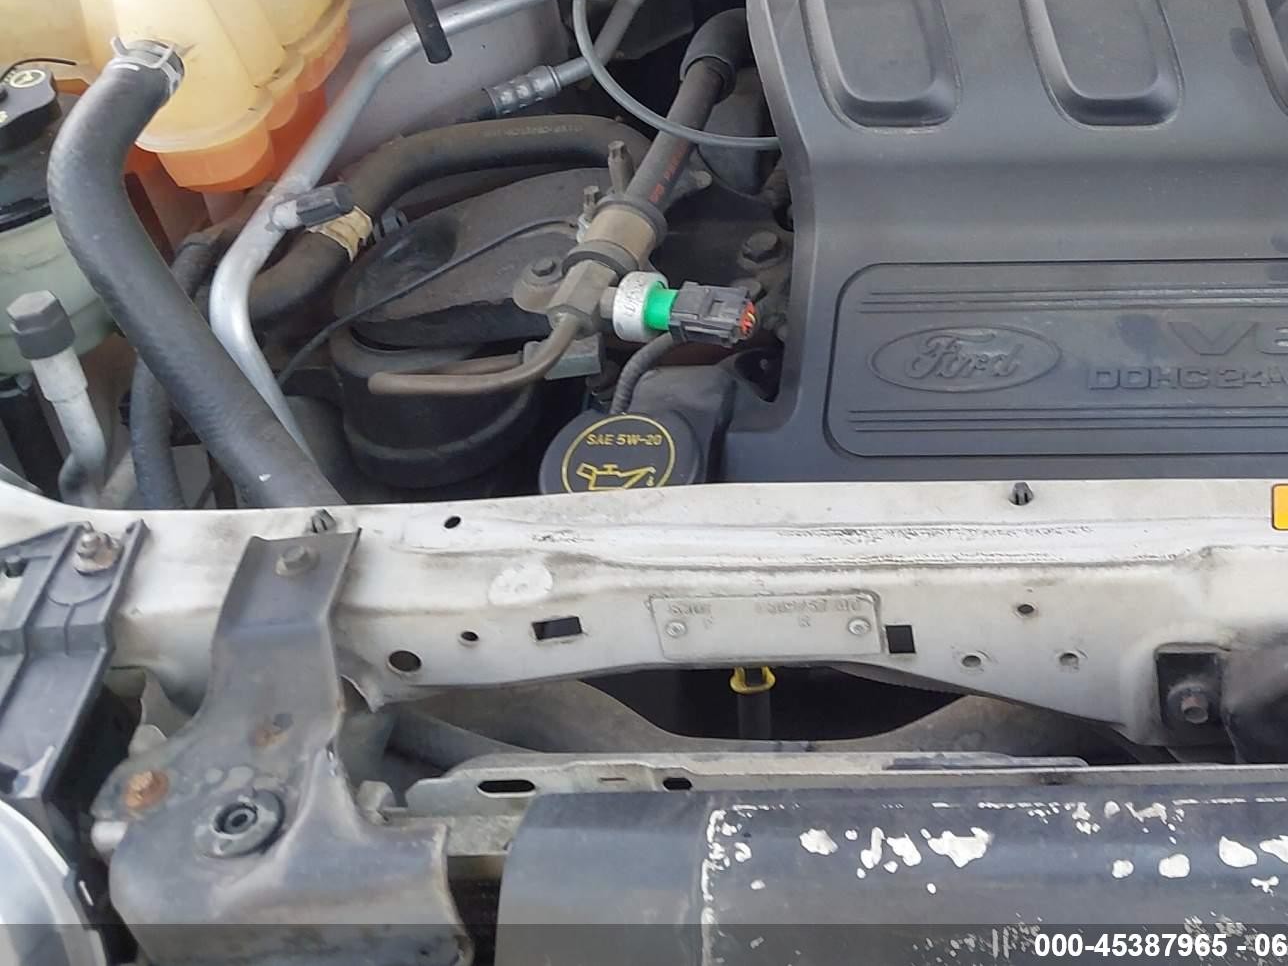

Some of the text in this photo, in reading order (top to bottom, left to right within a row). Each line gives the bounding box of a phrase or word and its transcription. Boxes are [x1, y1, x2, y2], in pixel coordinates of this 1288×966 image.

[904, 334, 1026, 380] Ford
[1088, 366, 1209, 391] DOHC
[586, 434, 662, 446] SAE 5W-20
